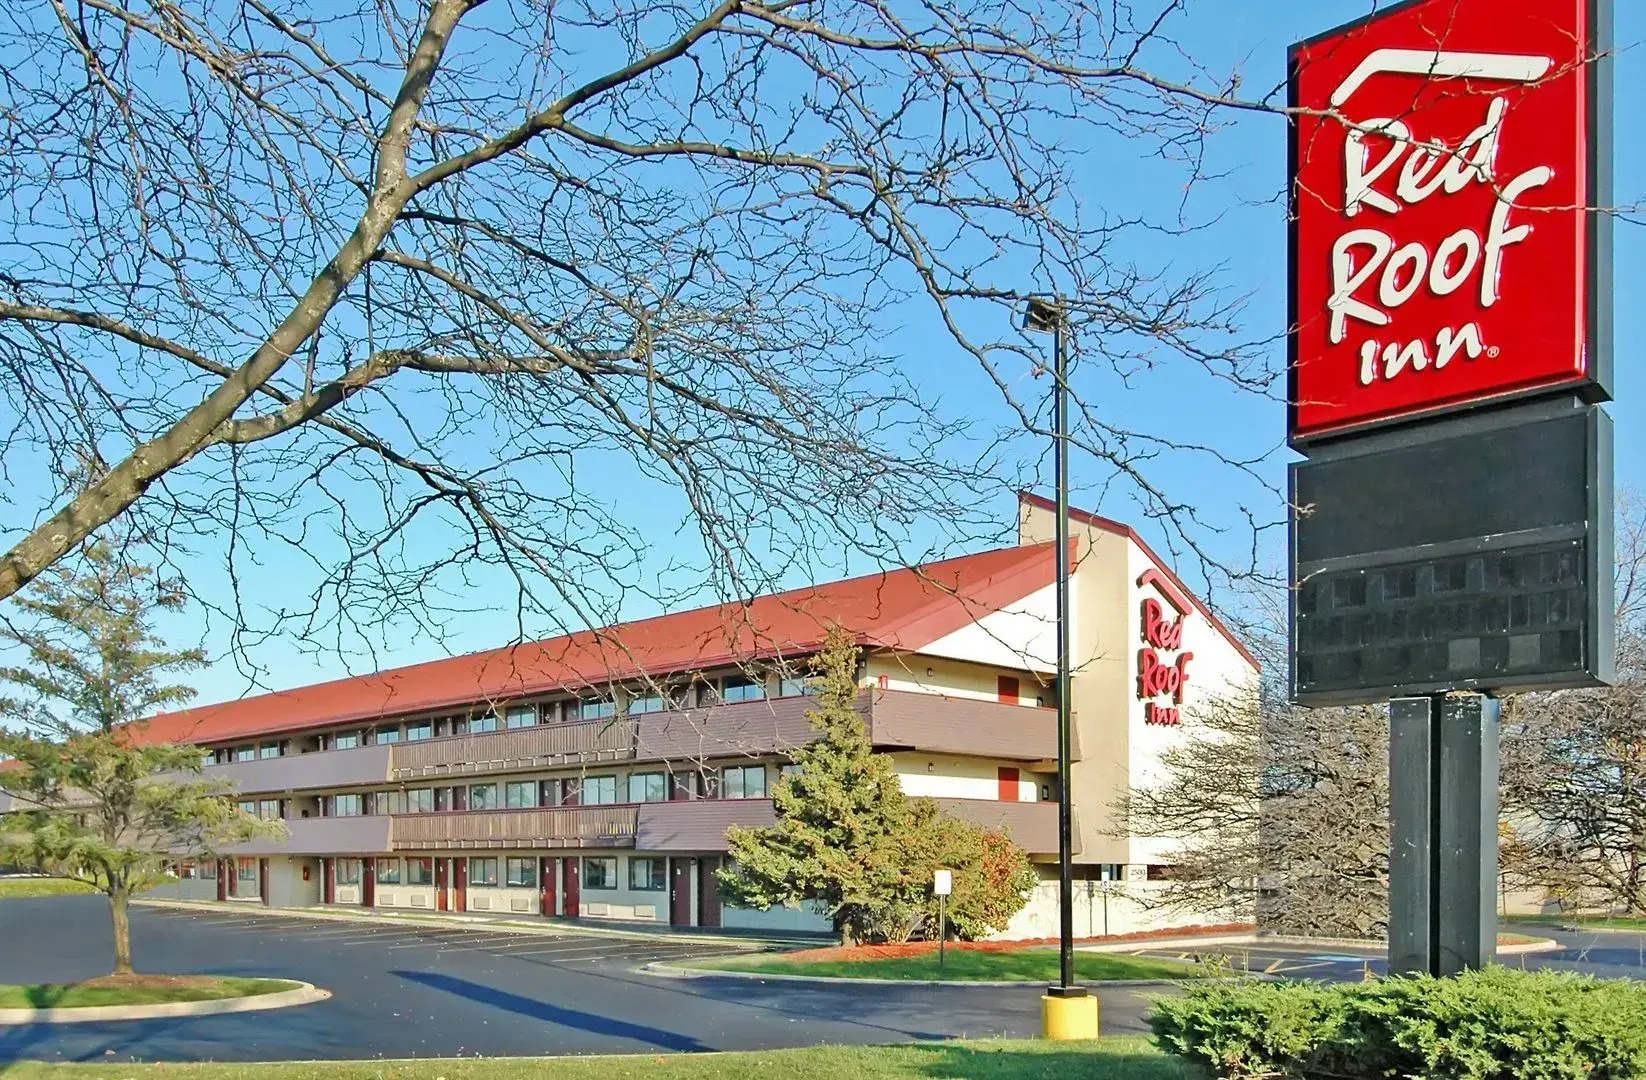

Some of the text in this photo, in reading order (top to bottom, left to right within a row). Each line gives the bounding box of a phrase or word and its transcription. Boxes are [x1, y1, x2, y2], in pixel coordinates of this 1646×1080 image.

[1345, 97, 1504, 217] Red
[1328, 166, 1551, 344] Roof
[1141, 598, 1185, 650] Red
[1137, 648, 1193, 705] Roof
[1145, 703, 1181, 726] Inn
